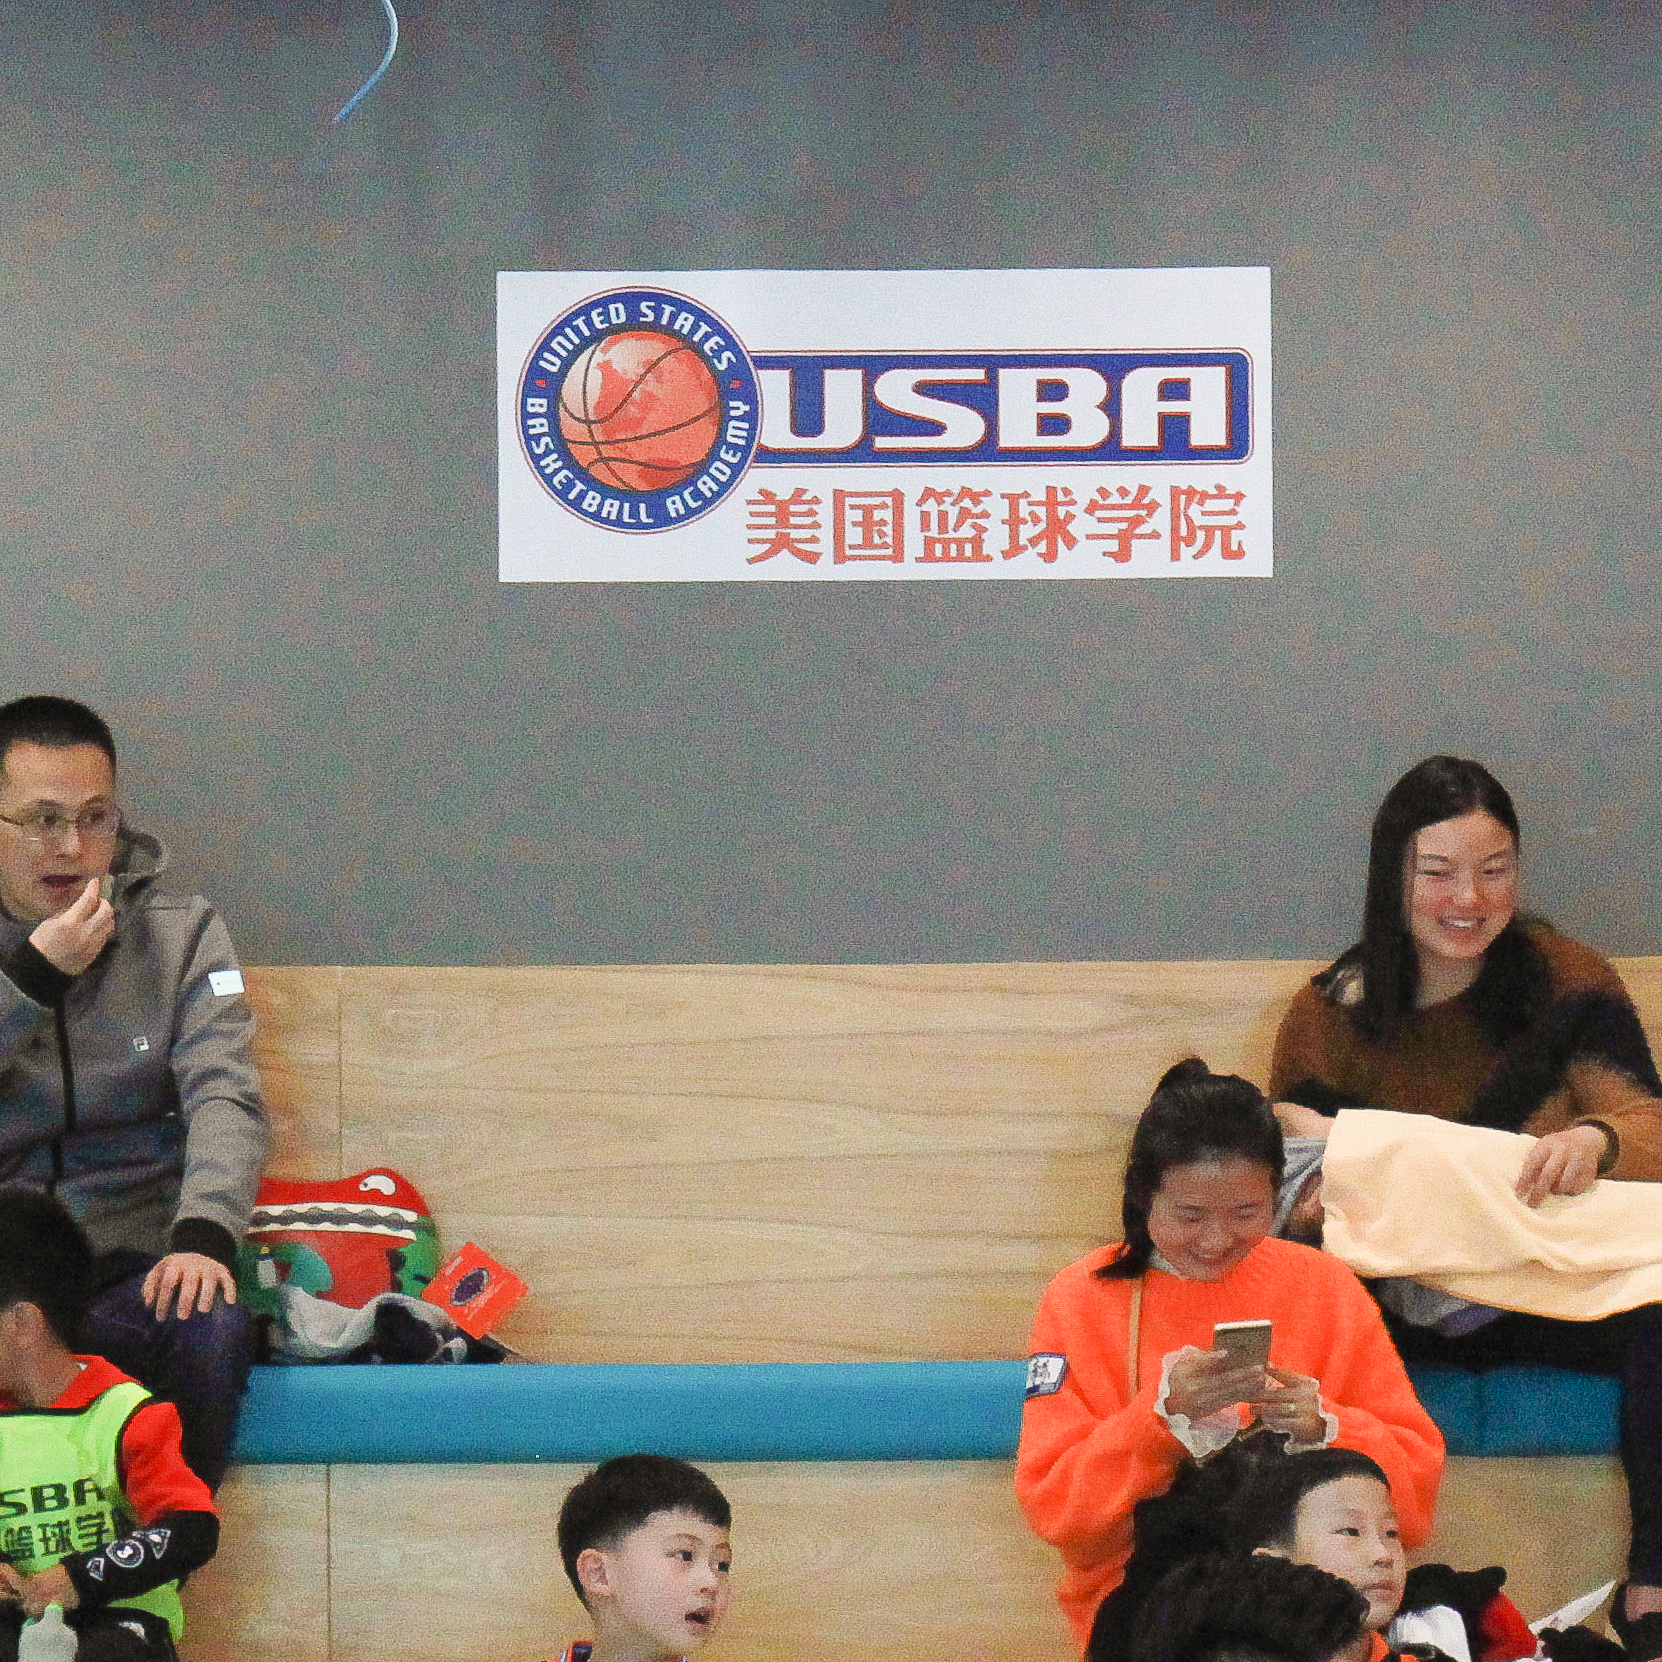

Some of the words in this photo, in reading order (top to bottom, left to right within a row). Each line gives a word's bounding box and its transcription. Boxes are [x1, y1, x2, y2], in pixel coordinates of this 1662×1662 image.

[540, 301, 628, 374] UNITED
[638, 300, 738, 372] STATES
[758, 365, 1231, 452] USBA
[527, 397, 655, 525] BASKETBALL
[665, 398, 750, 519] ACADEMY
[745, 483, 1249, 566] 美国篮球学院
